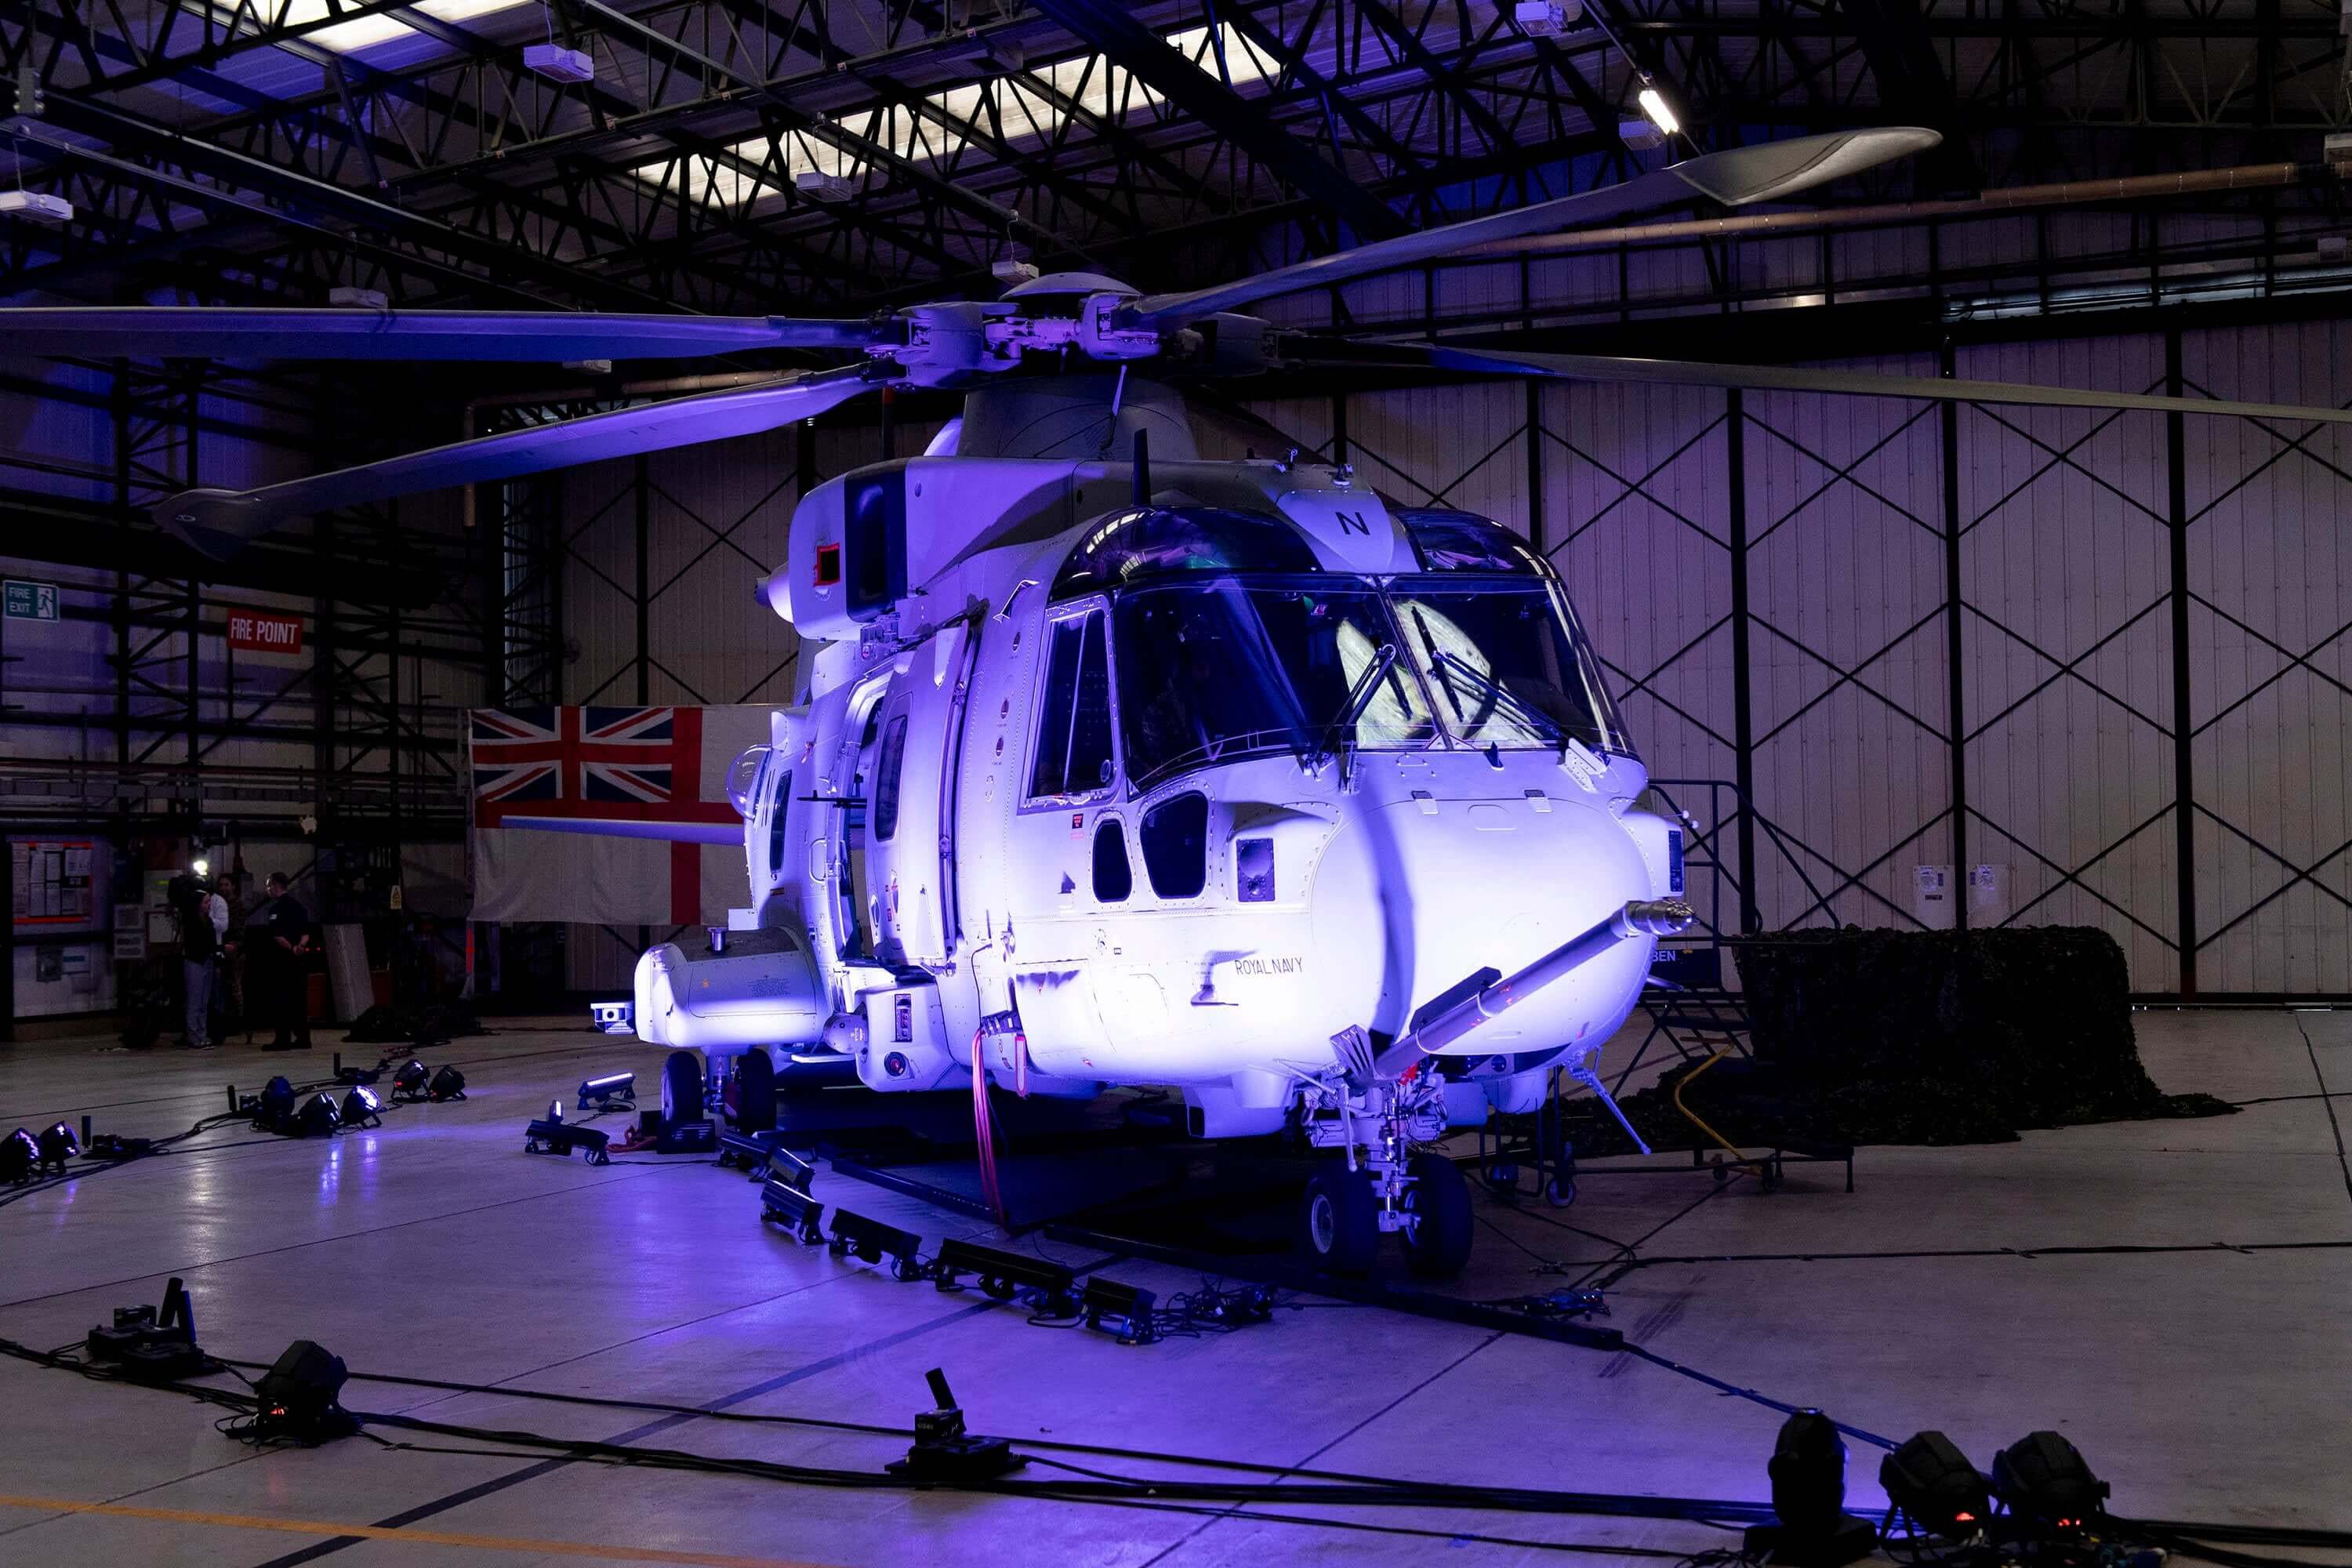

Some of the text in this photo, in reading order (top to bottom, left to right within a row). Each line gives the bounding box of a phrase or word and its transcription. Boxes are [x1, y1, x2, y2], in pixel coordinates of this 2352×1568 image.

[1335, 511, 1370, 535] N
[9, 586, 32, 600] FIRE
[9, 601, 31, 614] EXIT
[230, 617, 299, 645] FIRE POINT
[1235, 957, 1303, 975] ROYAL NAVY
